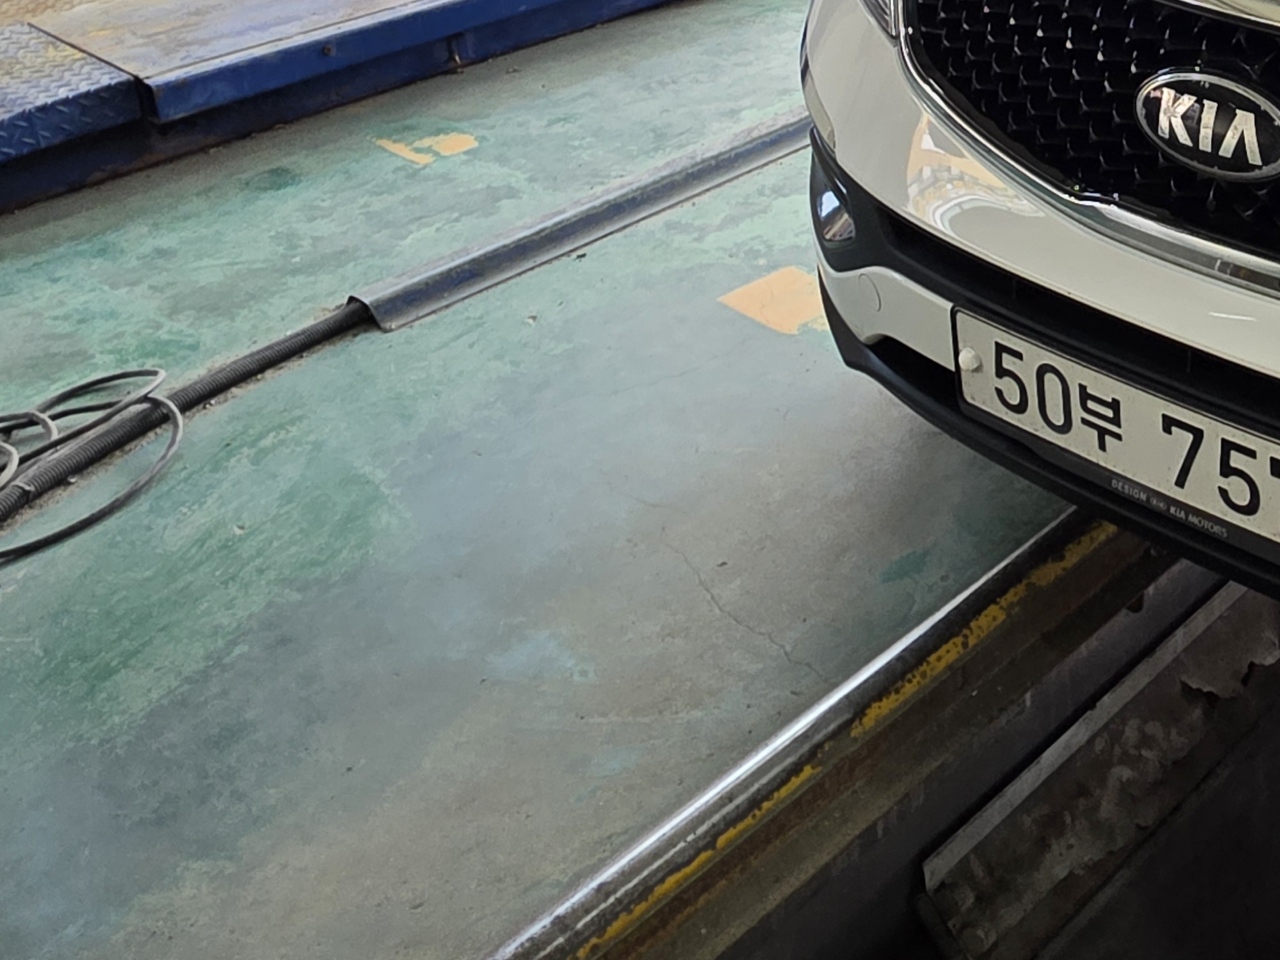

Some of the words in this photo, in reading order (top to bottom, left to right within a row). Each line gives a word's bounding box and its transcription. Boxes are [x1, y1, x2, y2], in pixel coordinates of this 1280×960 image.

[1157, 86, 1263, 166] KIA
[993, 339, 1124, 453] 50부
[1111, 478, 1147, 502] DESIGN
[1169, 504, 1186, 520] KIA
[1187, 512, 1228, 538] MOTORS
